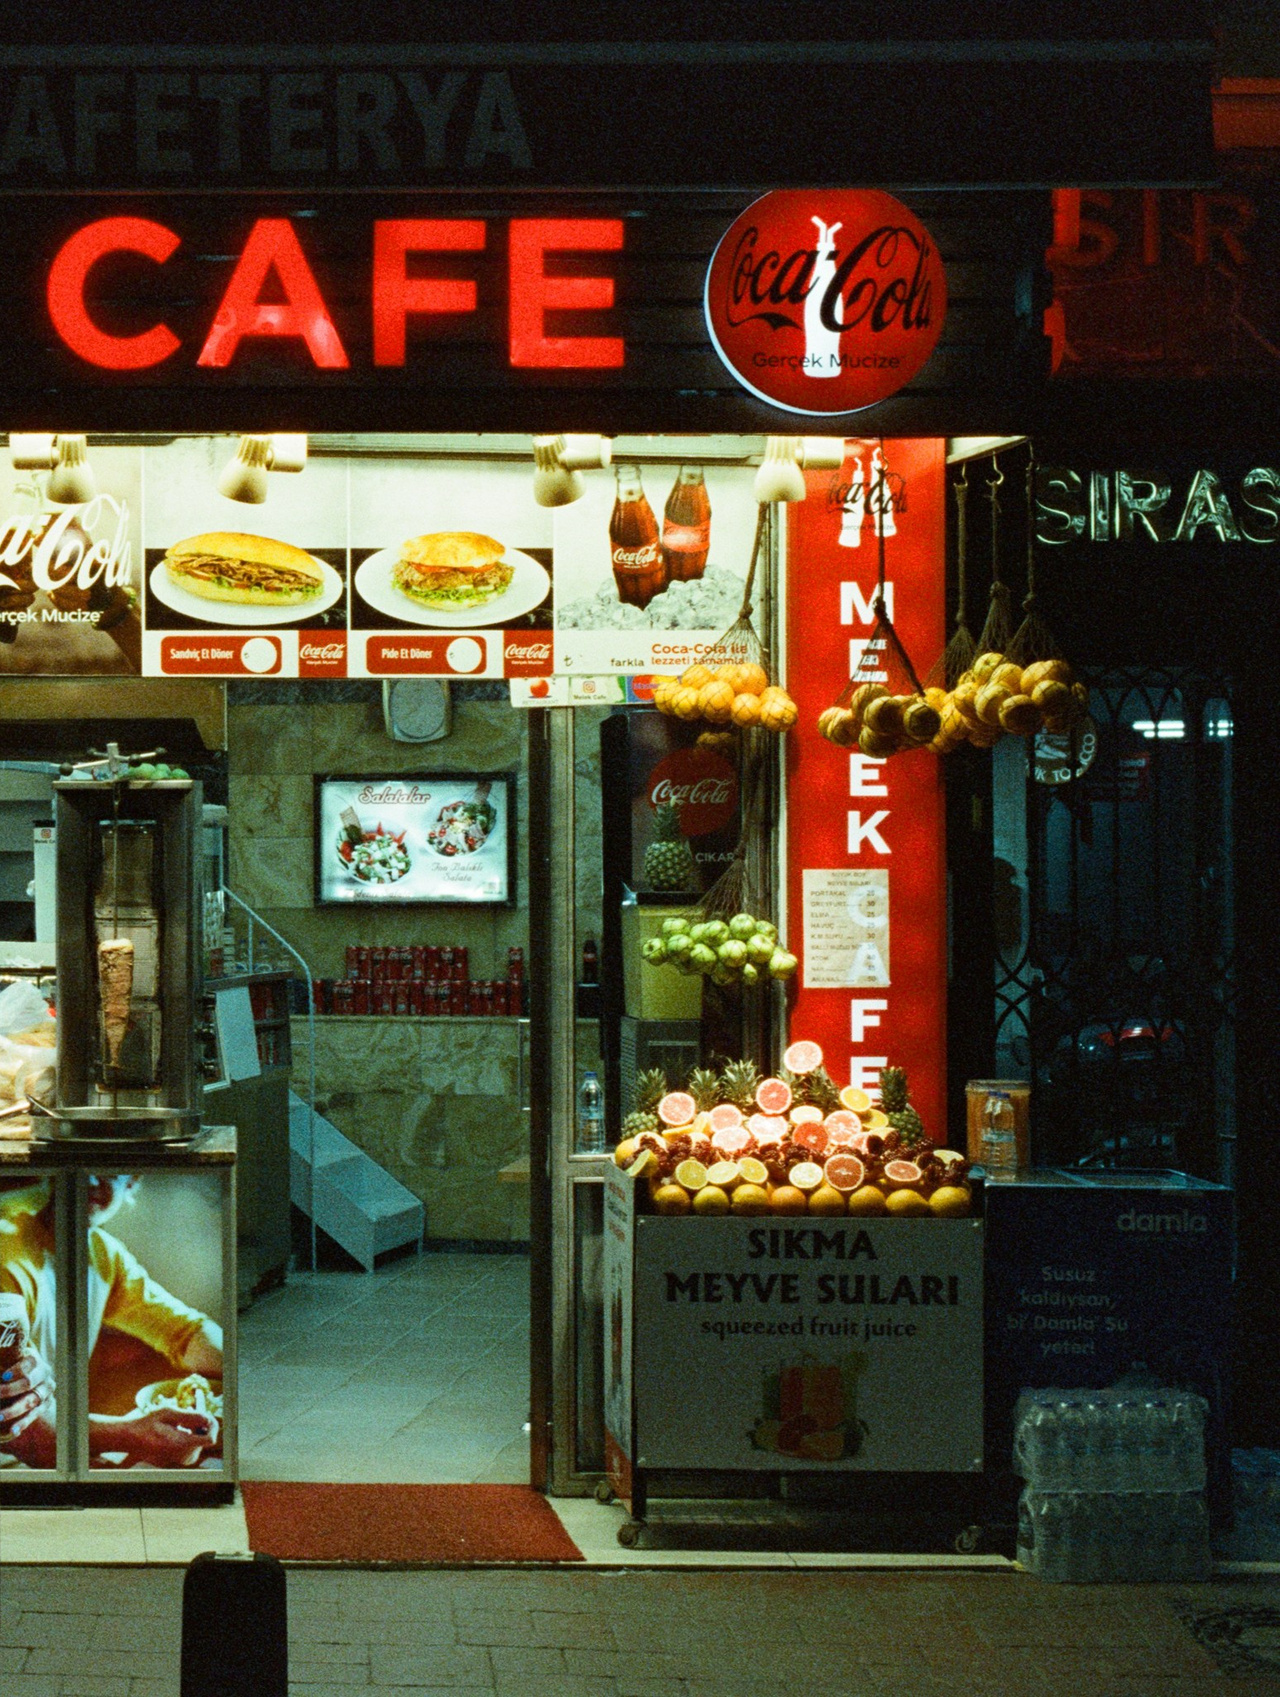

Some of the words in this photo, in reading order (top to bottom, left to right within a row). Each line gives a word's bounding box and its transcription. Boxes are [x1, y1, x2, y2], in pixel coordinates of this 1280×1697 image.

[726, 225, 931, 333] Coca-Cola
[46, 216, 624, 370] CAFE
[752, 352, 823, 370] Gerçek
[830, 352, 901, 369] Mucize
[41, 608, 101, 623] Mucize
[201, 648, 209, 659] Et
[210, 647, 234, 660] Döner
[299, 643, 346, 660] Coca-Cola
[381, 648, 399, 659] Pide
[400, 648, 409, 659] Et
[410, 647, 433, 659] Döner
[505, 643, 553, 660] Coca-Cola
[651, 643, 727, 654] Coca-Cola
[651, 656, 690, 666] lezzeti
[358, 785, 431, 804] Salatalar
[1116, 1208, 1208, 1232] damla
[748, 1229, 877, 1260] SIKMA
[664, 1272, 800, 1304] MEYVE
[817, 1273, 960, 1306] SULARI
[701, 1315, 804, 1340] squeezed
[810, 1316, 858, 1336] fruit
[862, 1316, 917, 1342] juice
